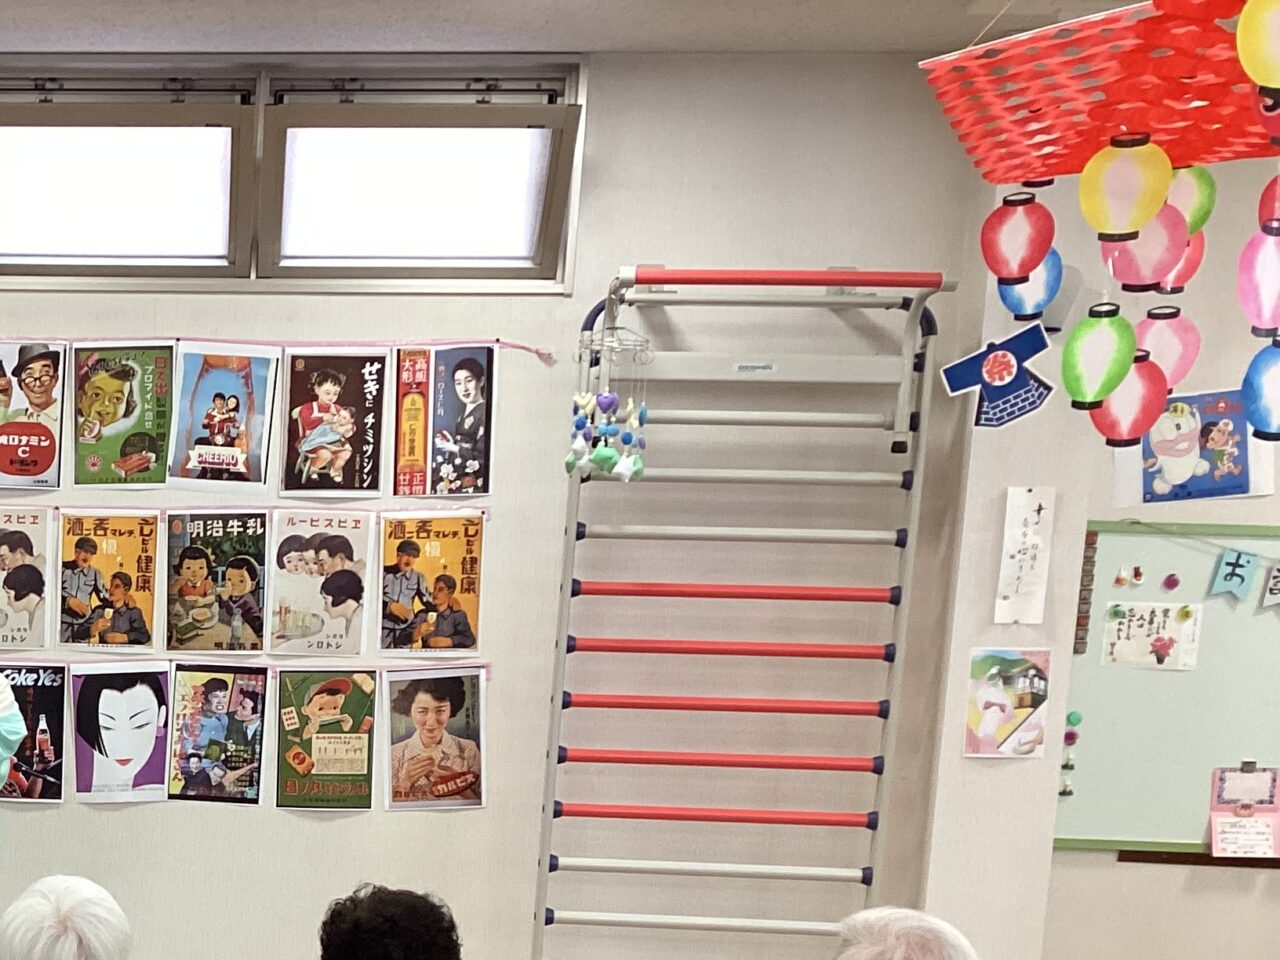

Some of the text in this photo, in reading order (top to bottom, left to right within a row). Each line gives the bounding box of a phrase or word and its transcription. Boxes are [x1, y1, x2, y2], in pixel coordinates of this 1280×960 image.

[17, 446, 30, 458] C
[196, 451, 238, 468] CHEERIO
[186, 518, 265, 538] 明治牛乳
[1224, 551, 1251, 587] お
[37, 668, 64, 687] Yes
